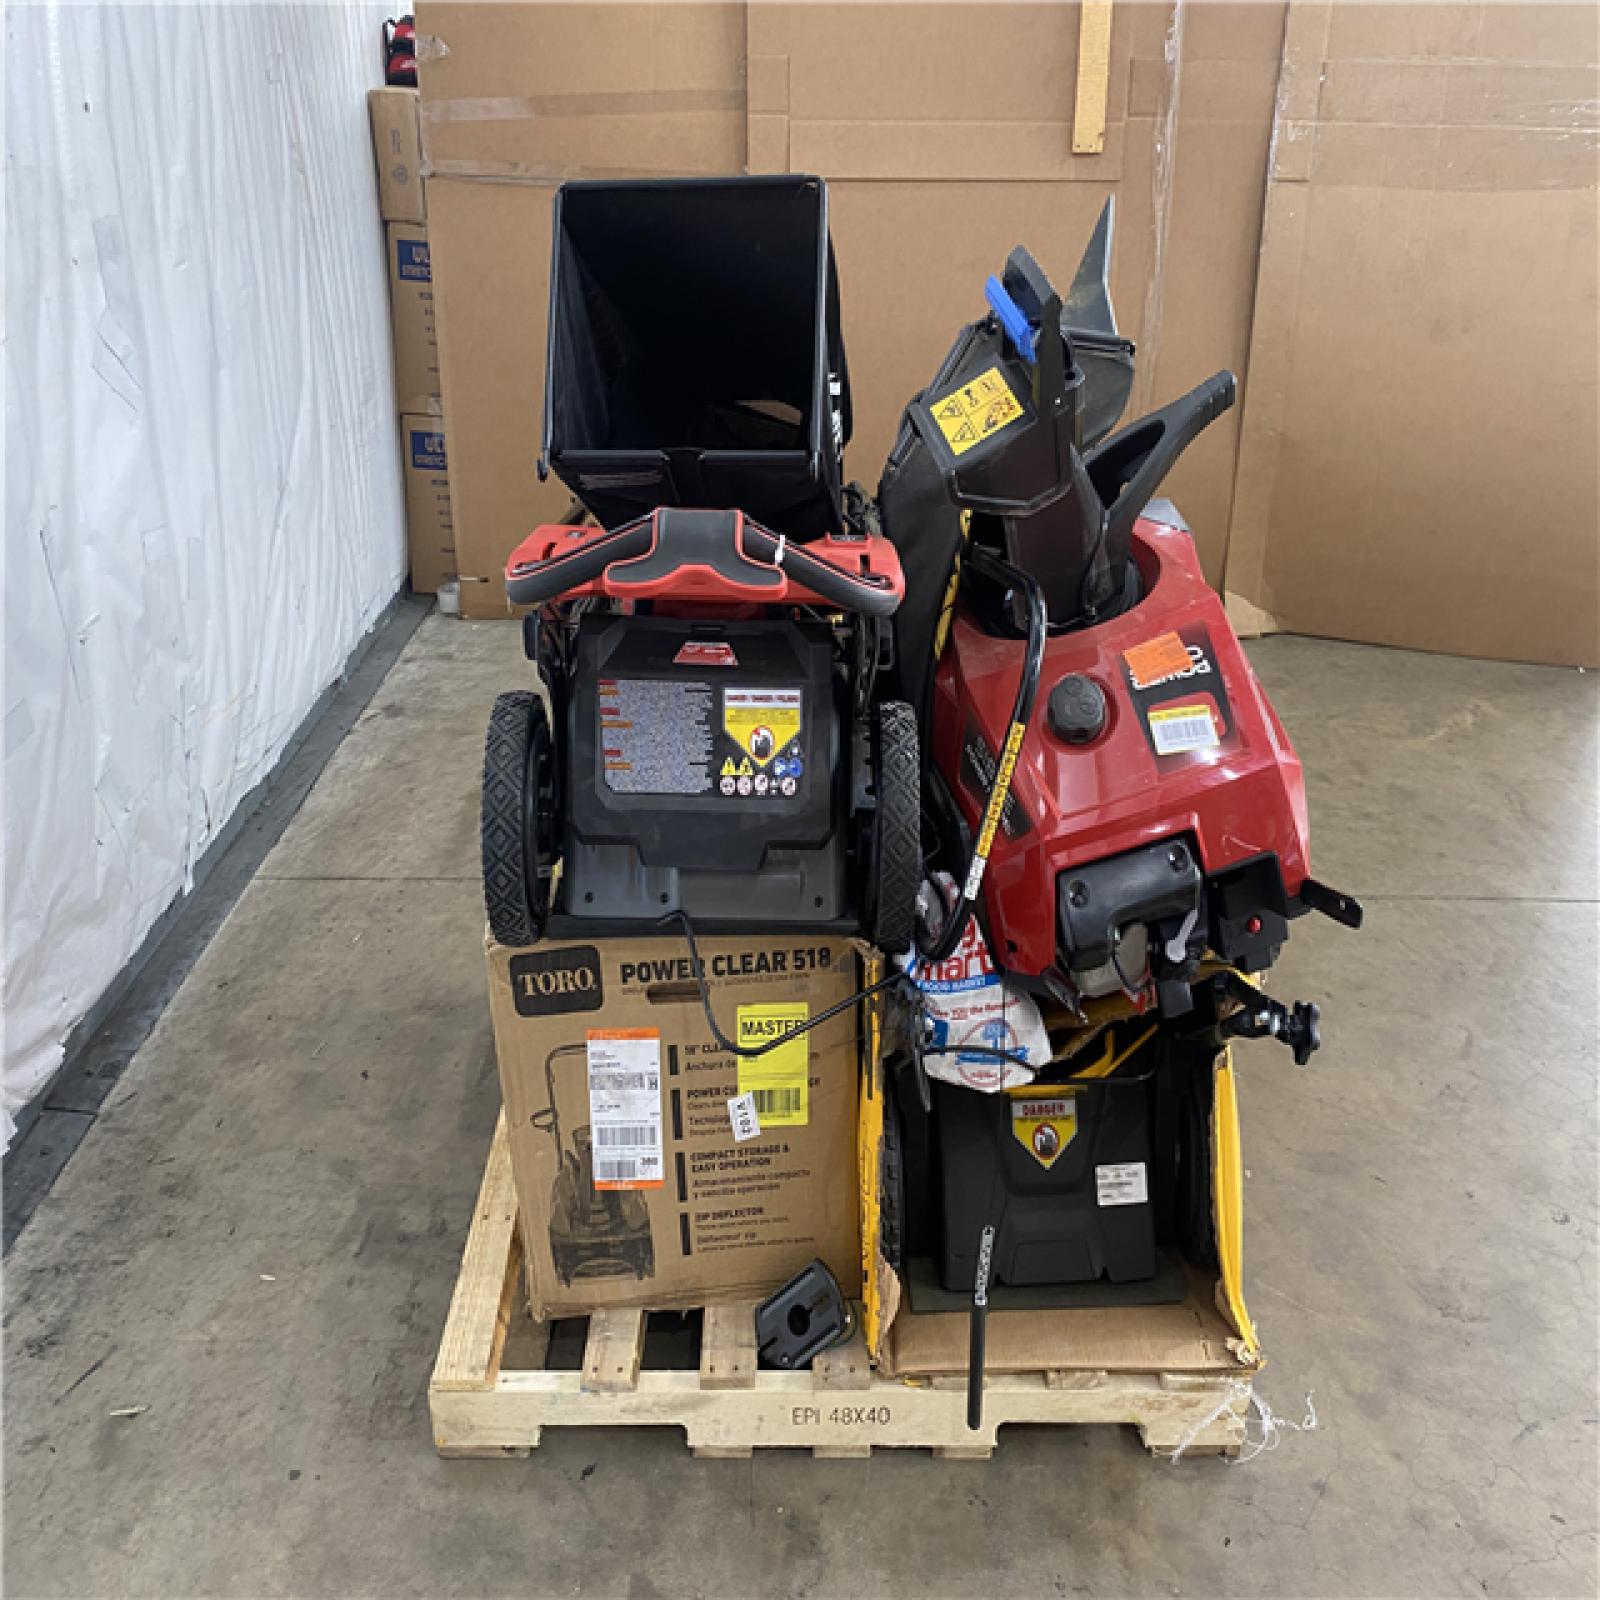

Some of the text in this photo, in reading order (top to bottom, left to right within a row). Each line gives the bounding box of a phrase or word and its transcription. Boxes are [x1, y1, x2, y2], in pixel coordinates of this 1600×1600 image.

[620, 957, 706, 985] POWER
[711, 951, 787, 976] CLEAR
[793, 946, 831, 971] 518
[517, 966, 597, 996] TORO
[1022, 1102, 1066, 1116] DANGER
[791, 1405, 891, 1426] EPI 48X40
